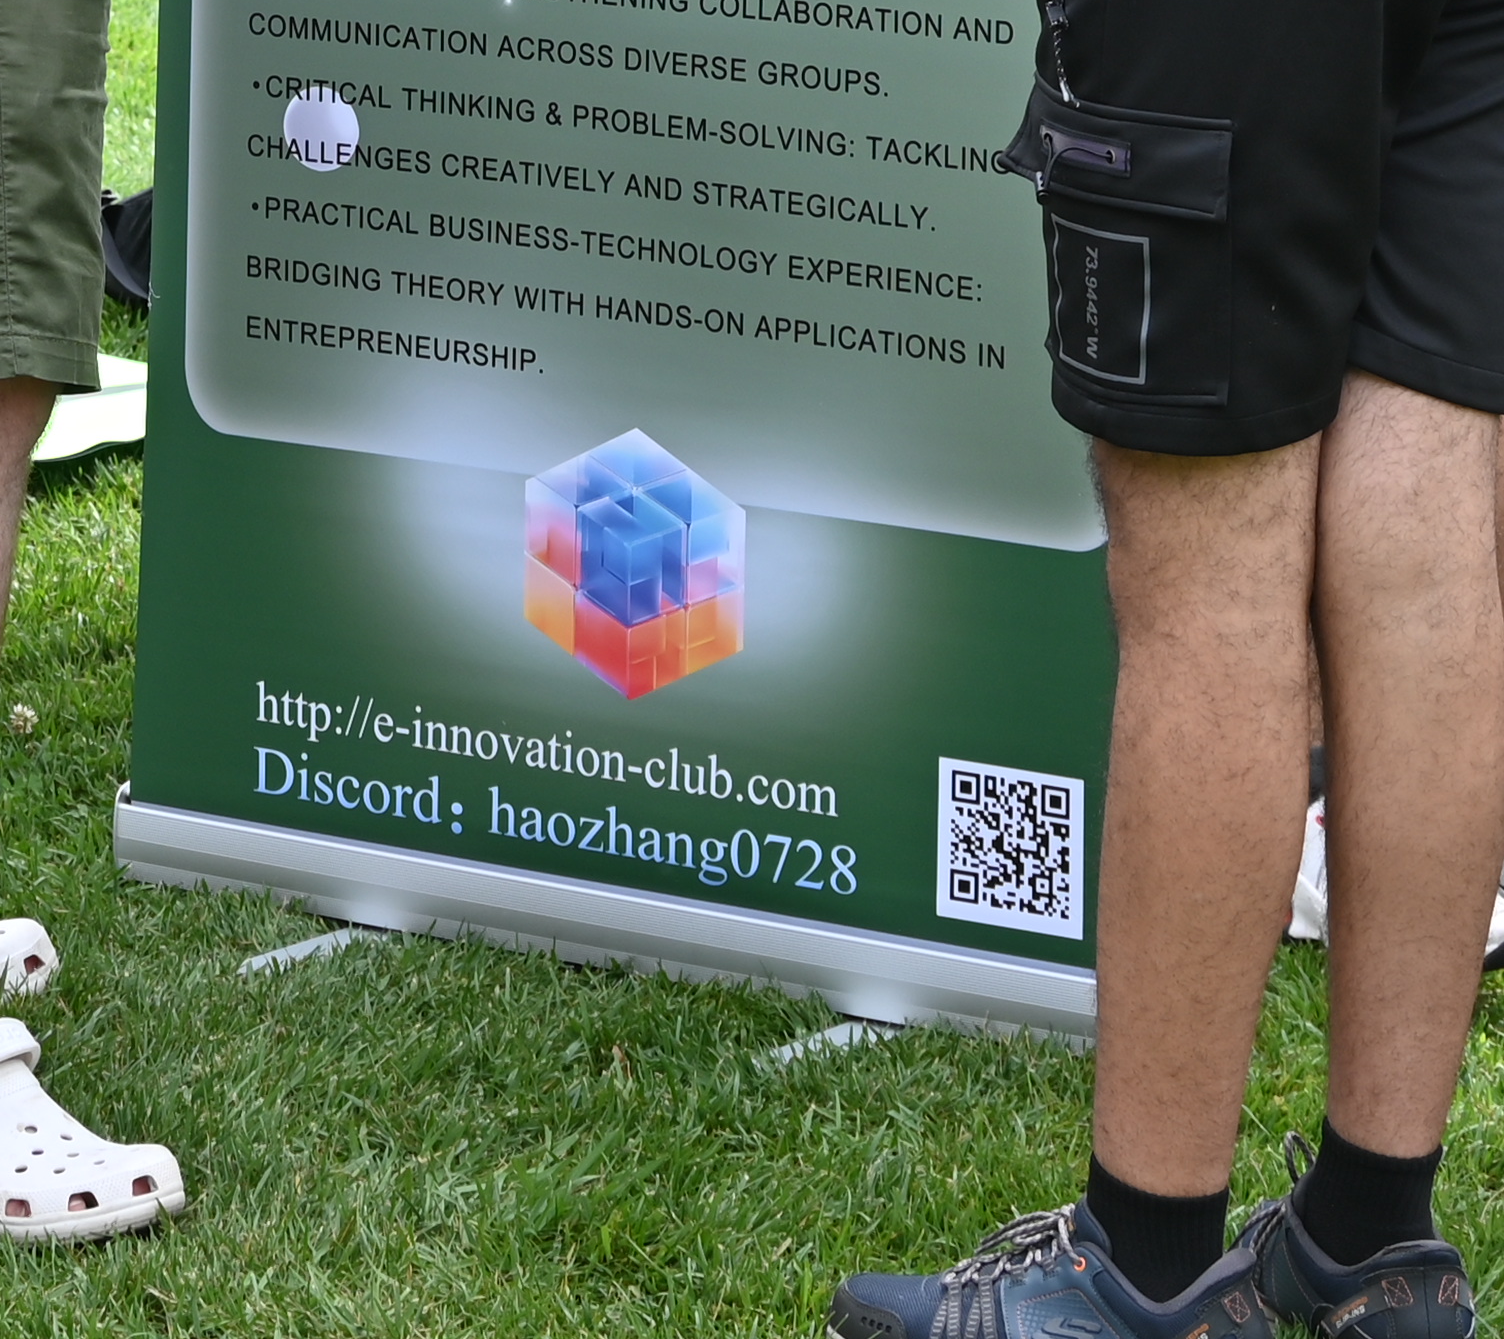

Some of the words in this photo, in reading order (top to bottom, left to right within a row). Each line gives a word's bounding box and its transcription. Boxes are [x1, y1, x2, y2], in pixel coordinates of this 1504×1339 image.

[248, 12, 487, 56] COMMUNICATION
[497, 34, 614, 69] ACROSS
[624, 46, 747, 83] DIVERSE
[757, 60, 889, 98] GROUPS.
[952, 16, 1014, 45] AND
[265, 75, 392, 109] CRITICAL
[401, 87, 535, 123] THINKING
[545, 101, 563, 126] &
[573, 104, 855, 158] PROBLEM-SOLVING:
[247, 133, 431, 174] CHALLENGES
[441, 153, 615, 194] CREATIVELY
[623, 173, 682, 202] AND
[692, 180, 936, 232] STRATEGICALLY.
[265, 196, 419, 235] PRACTICAL
[429, 213, 778, 276] BUSINESS-TECHNOLOGY
[788, 254, 982, 302] EXPERIENCE:
[246, 254, 381, 292] BRIDGING
[390, 270, 505, 306] THEORY
[514, 285, 584, 317] WITH
[595, 294, 744, 337] HANDS-ON
[754, 315, 966, 365] APPLICATIONS
[978, 342, 1005, 370] IN
[246, 315, 544, 374] ENTREPRENEURSHIP.
[255, 680, 839, 818] http://e-innovation-club.com
[488, 785, 857, 895] haozhang0728
